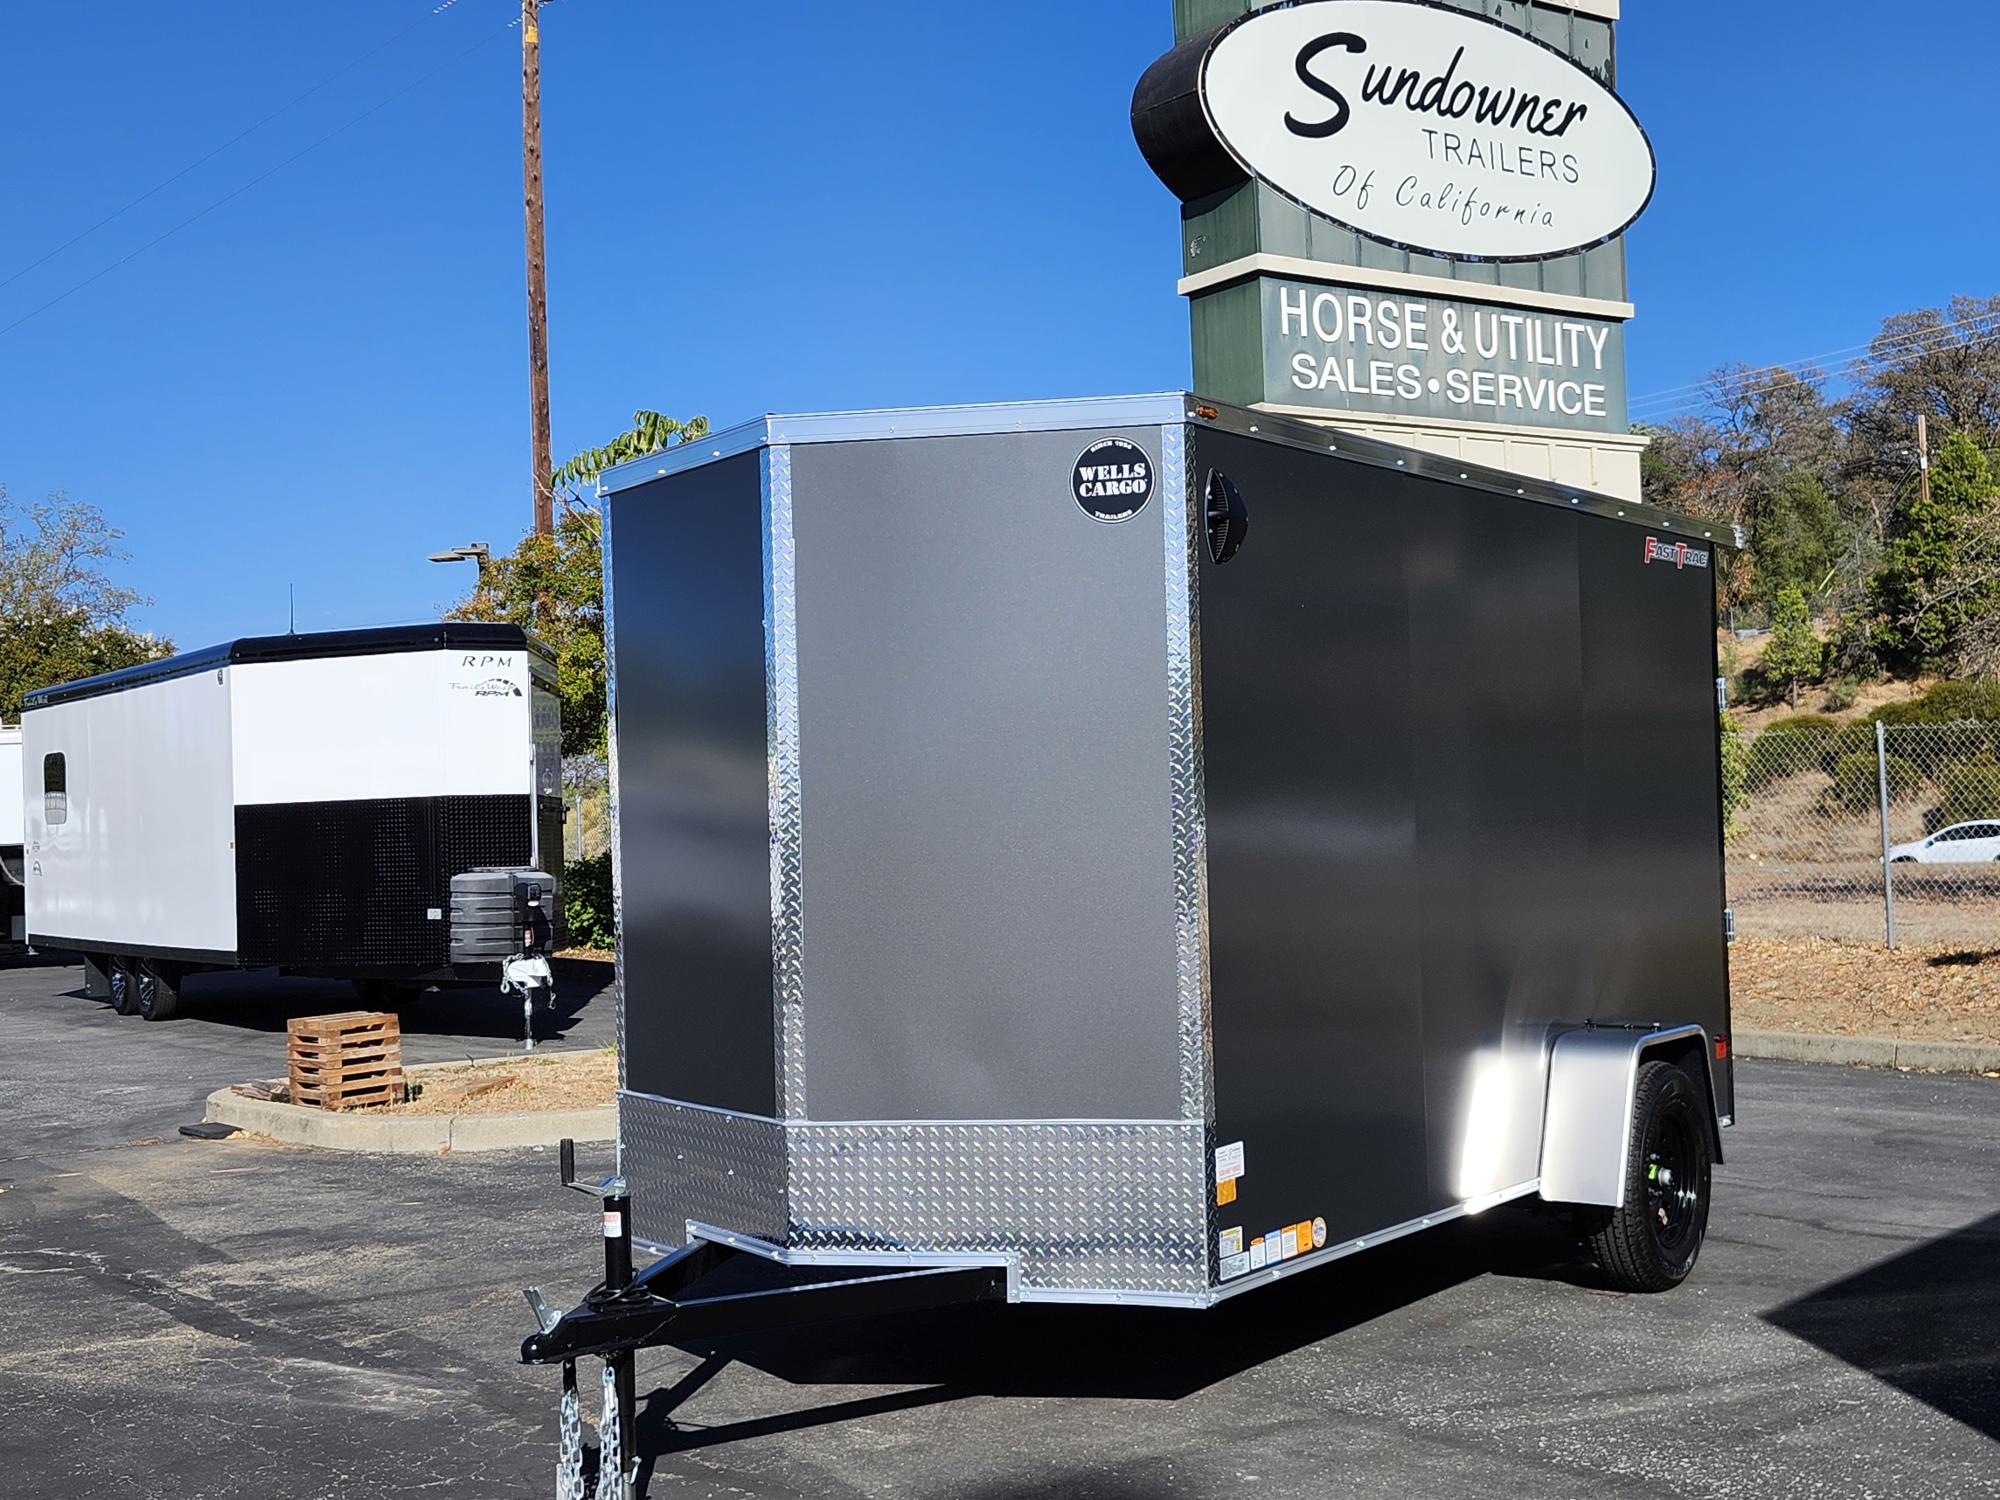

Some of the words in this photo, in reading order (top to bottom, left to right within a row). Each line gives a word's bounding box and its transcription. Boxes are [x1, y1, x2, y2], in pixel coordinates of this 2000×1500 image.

[1284, 32, 1588, 138] Sundowner
[1421, 128, 1579, 183] TRAILERS
[1332, 165, 1375, 210] Of
[1395, 175, 1553, 227] California
[1280, 287, 1429, 351] HORSE
[1441, 308, 1466, 354] &
[1474, 311, 1609, 370] UTILITY
[1291, 353, 1422, 400] SALES
[1446, 368, 1606, 417] SERVICE
[1079, 463, 1146, 481] WELLS
[1079, 479, 1147, 497] CARGO
[1094, 509, 1133, 520] TRAILERS
[462, 655, 512, 667] RPM
